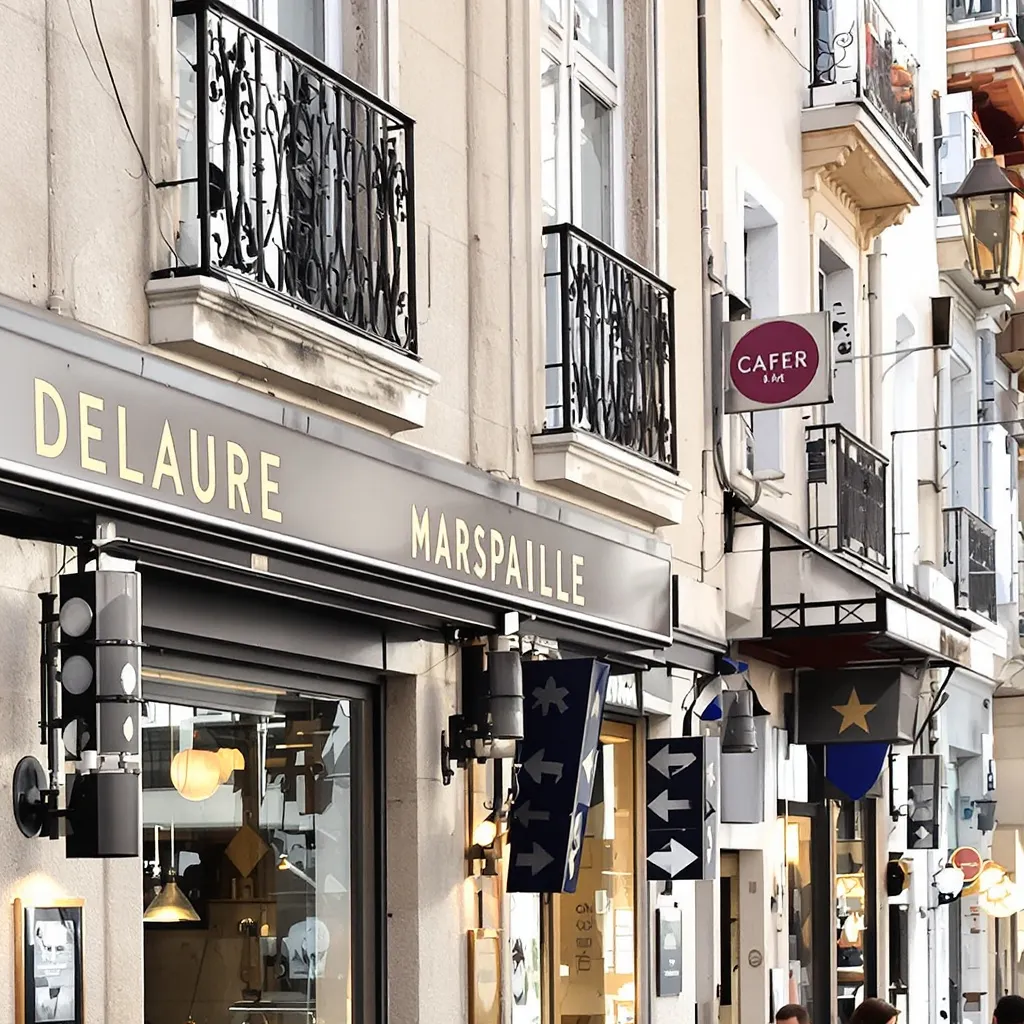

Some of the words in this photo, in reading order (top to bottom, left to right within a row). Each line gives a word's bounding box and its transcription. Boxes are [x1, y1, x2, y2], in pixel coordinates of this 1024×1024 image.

[737, 350, 808, 374] CAFER
[34, 377, 284, 523] DELAURE
[411, 503, 585, 606] MARSPAILLE
